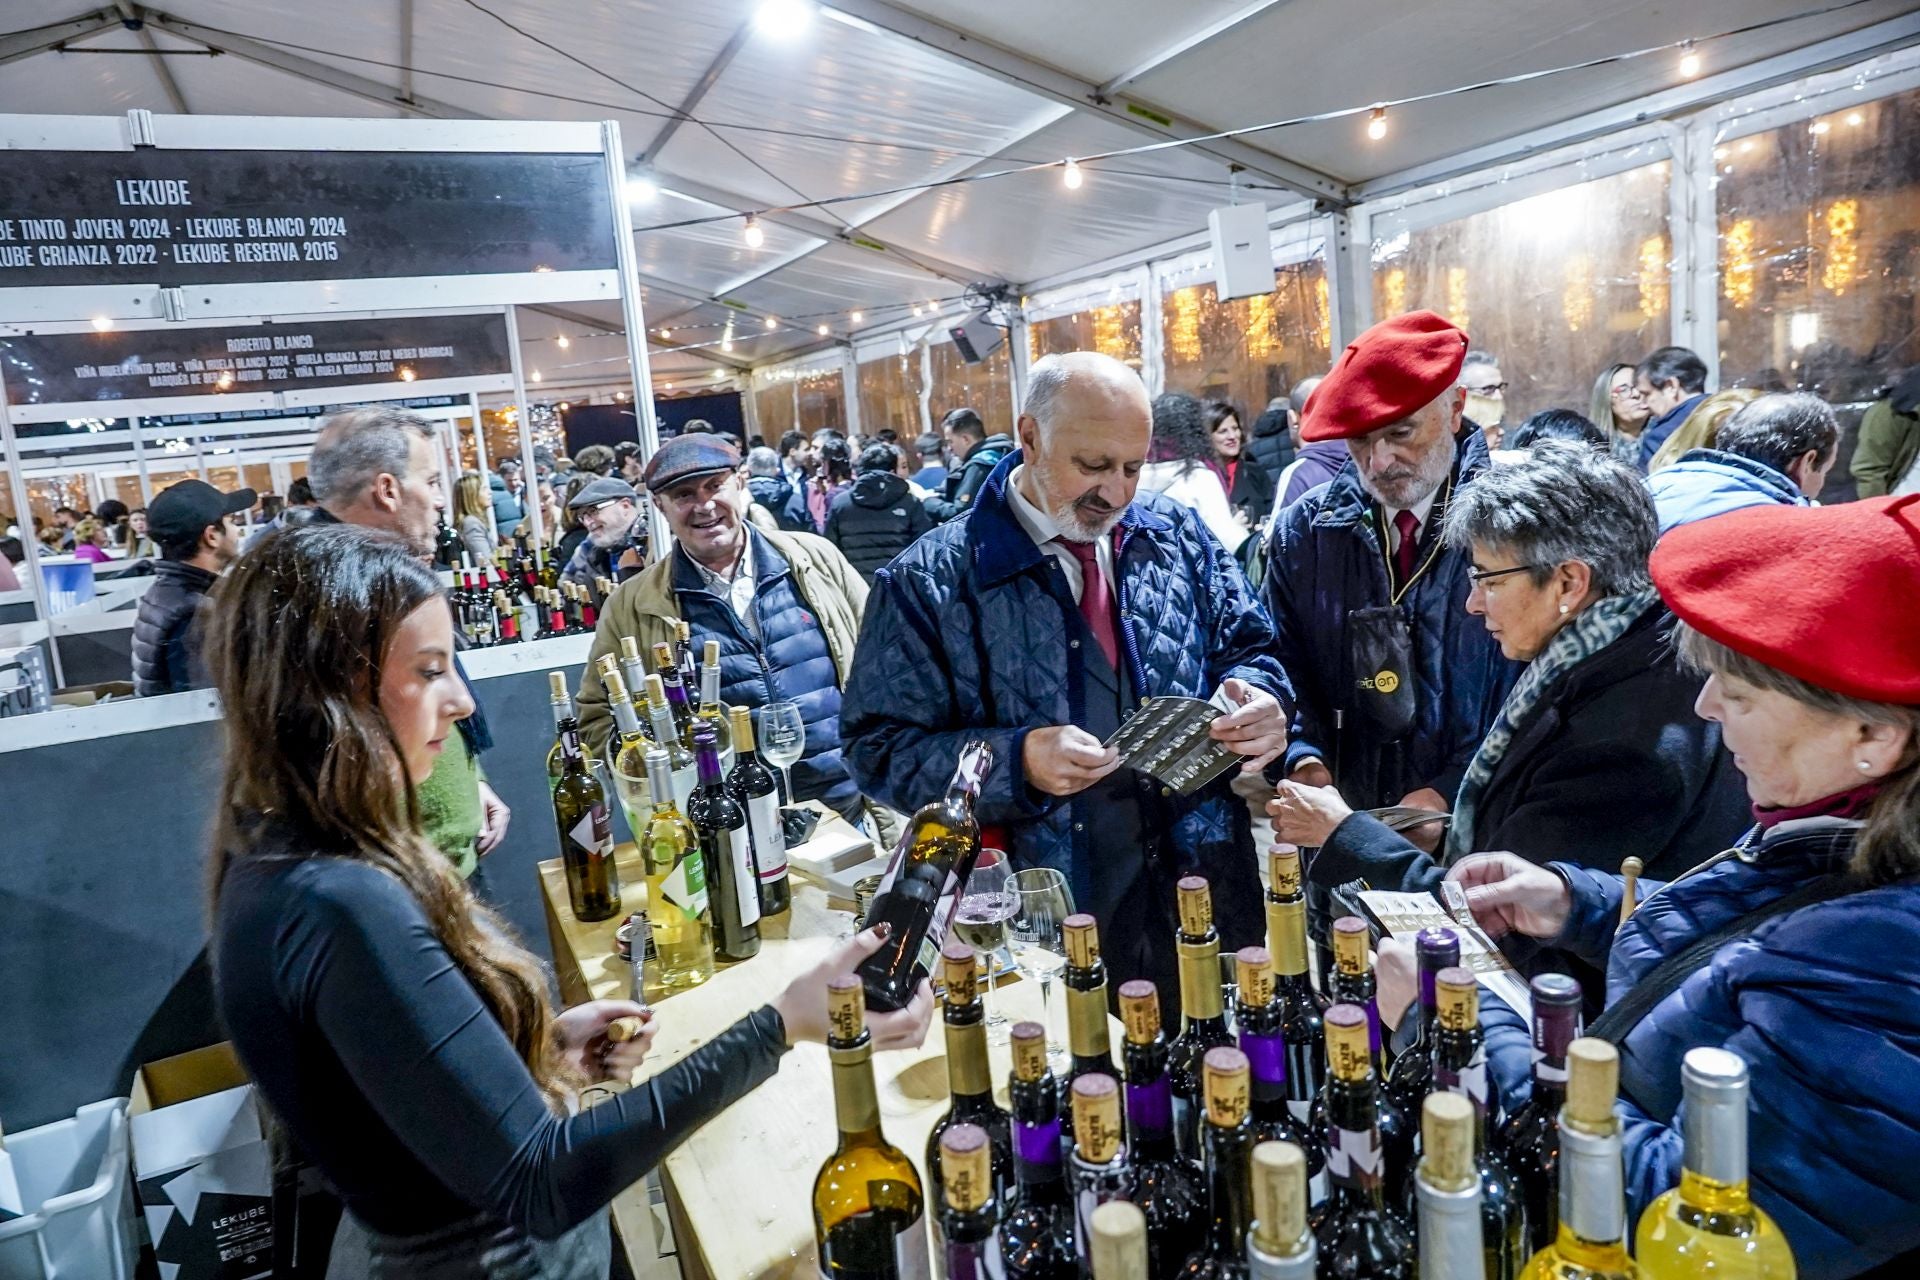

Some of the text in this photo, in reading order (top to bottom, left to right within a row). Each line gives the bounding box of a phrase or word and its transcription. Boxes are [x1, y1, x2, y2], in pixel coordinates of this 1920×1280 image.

[116, 179, 192, 206] LEKUBE
[19, 219, 67, 240] TINTO
[72, 218, 126, 240] JOVEN
[129, 218, 171, 240] 2024
[186, 217, 243, 239] LEKUBE
[247, 217, 306, 238] BLANCO
[310, 216, 347, 237] 2024
[38, 244, 112, 266] CRIANZA
[116, 243, 158, 265] 2022
[173, 243, 231, 264] LEKUBE
[234, 242, 300, 263] RESERVA
[303, 241, 339, 261] 2015
[226, 335, 314, 352] ROBERTO BLANCO
[74, 365, 97, 378] VIÑA
[154, 361, 177, 374] 2024
[183, 359, 204, 372] VIÑA
[235, 356, 267, 369] BLANCO
[268, 355, 290, 367] 2024
[324, 351, 358, 364] CRIANZA
[359, 350, 379, 362] 2022
[148, 373, 189, 388] MARQUÉS
[190, 373, 203, 385] DE
[267, 368, 288, 380] 2022
[294, 365, 314, 378] VIÑA
[375, 361, 395, 373] 2024
[212, 1205, 266, 1229] LEKUBE
